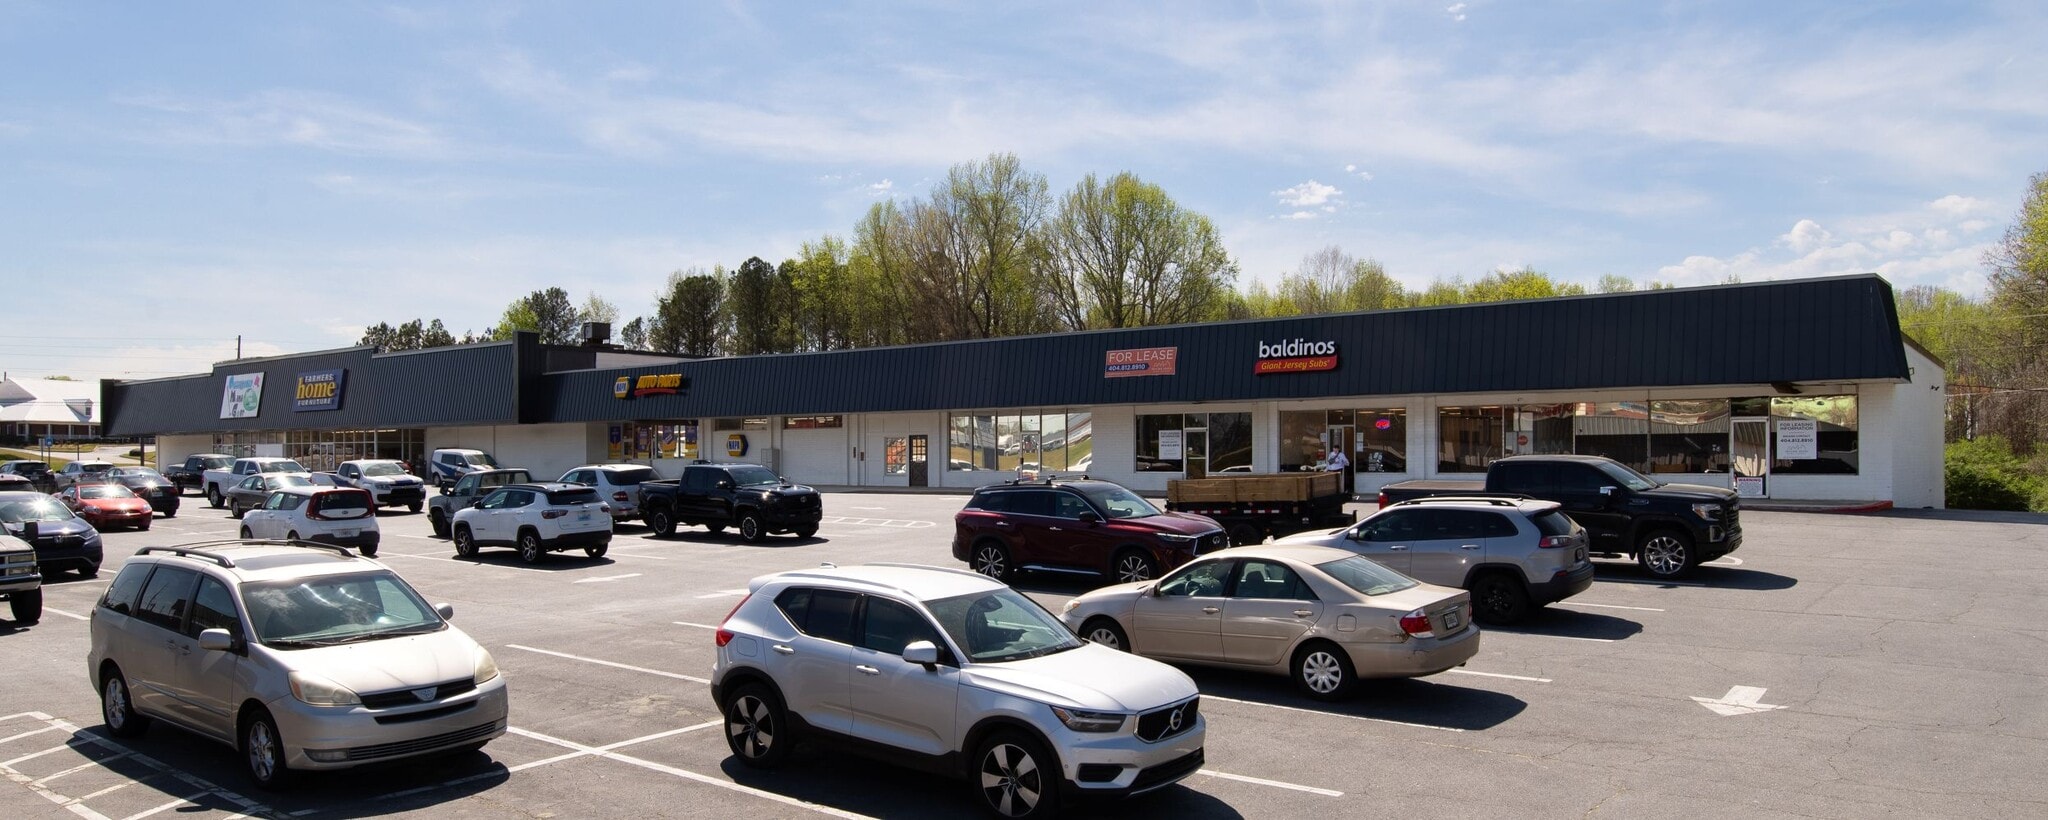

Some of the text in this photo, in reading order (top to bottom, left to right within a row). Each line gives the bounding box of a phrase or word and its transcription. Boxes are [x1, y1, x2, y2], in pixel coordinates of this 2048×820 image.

[1259, 338, 1336, 358] baldinos
[1109, 349, 1174, 363] FOR LEASE
[1261, 362, 1282, 370] Giant
[1283, 360, 1307, 371] Jersey
[304, 374, 334, 383] FARMERS
[636, 373, 682, 389] AUTO PARTS
[296, 377, 336, 400] home
[616, 382, 627, 392] NAPA
[728, 440, 740, 450] NAPA
